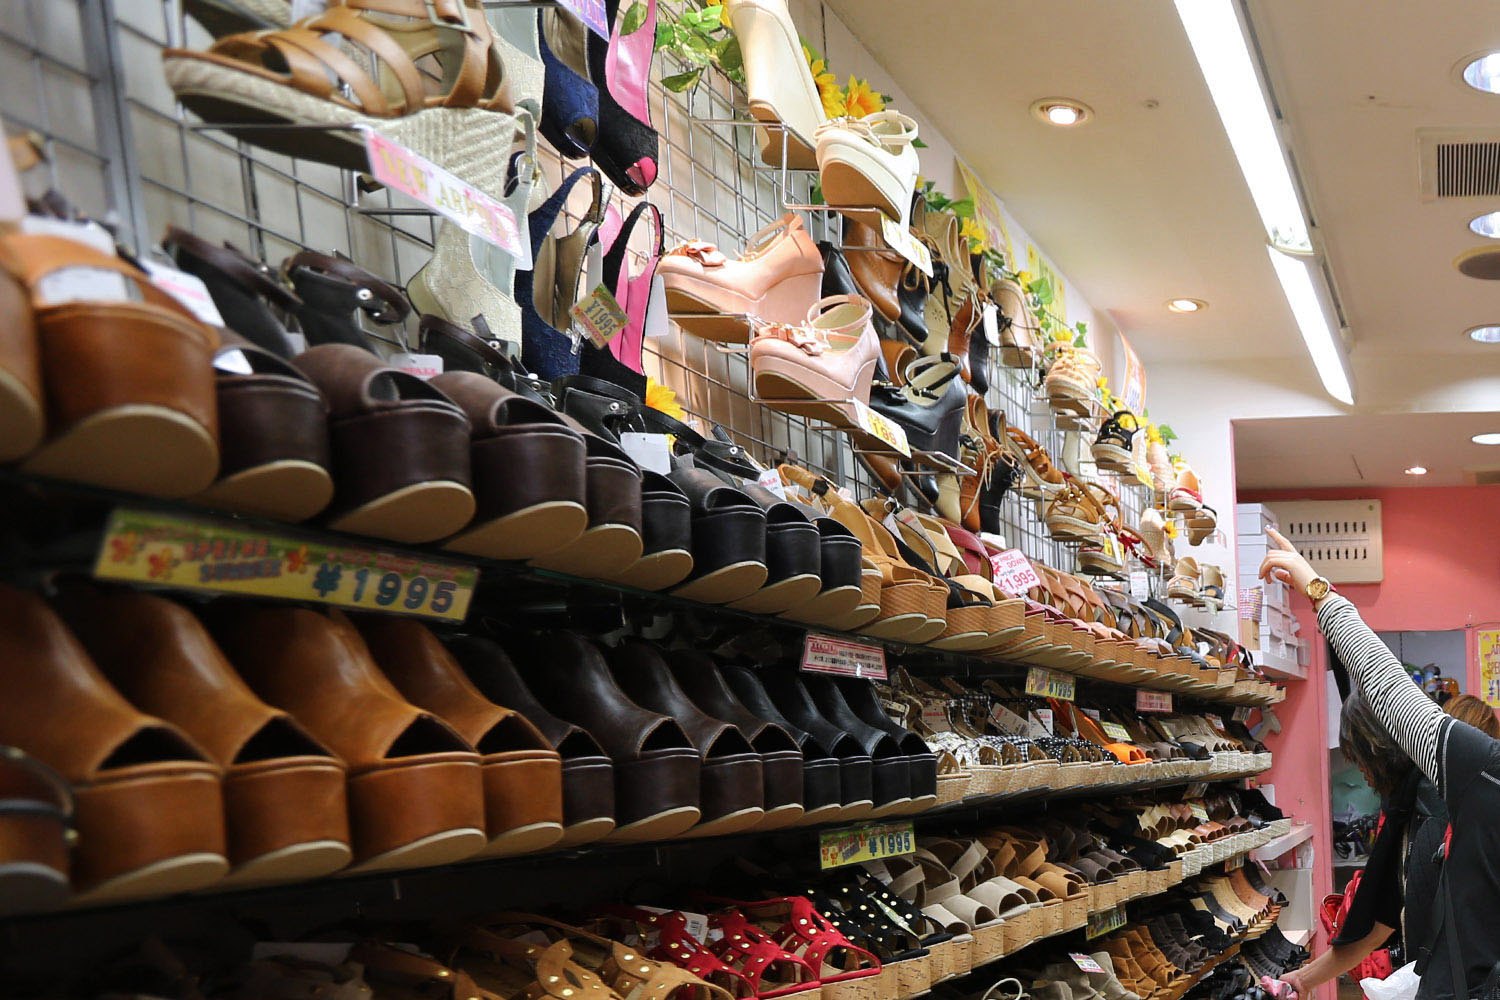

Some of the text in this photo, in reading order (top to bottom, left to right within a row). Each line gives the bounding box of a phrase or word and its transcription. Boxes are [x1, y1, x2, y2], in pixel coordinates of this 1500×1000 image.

[584, 300, 618, 336] ¥1995
[313, 562, 457, 613] ¥1995
[995, 569, 1036, 591] ¥1,995
[869, 832, 910, 856] ¥1995
